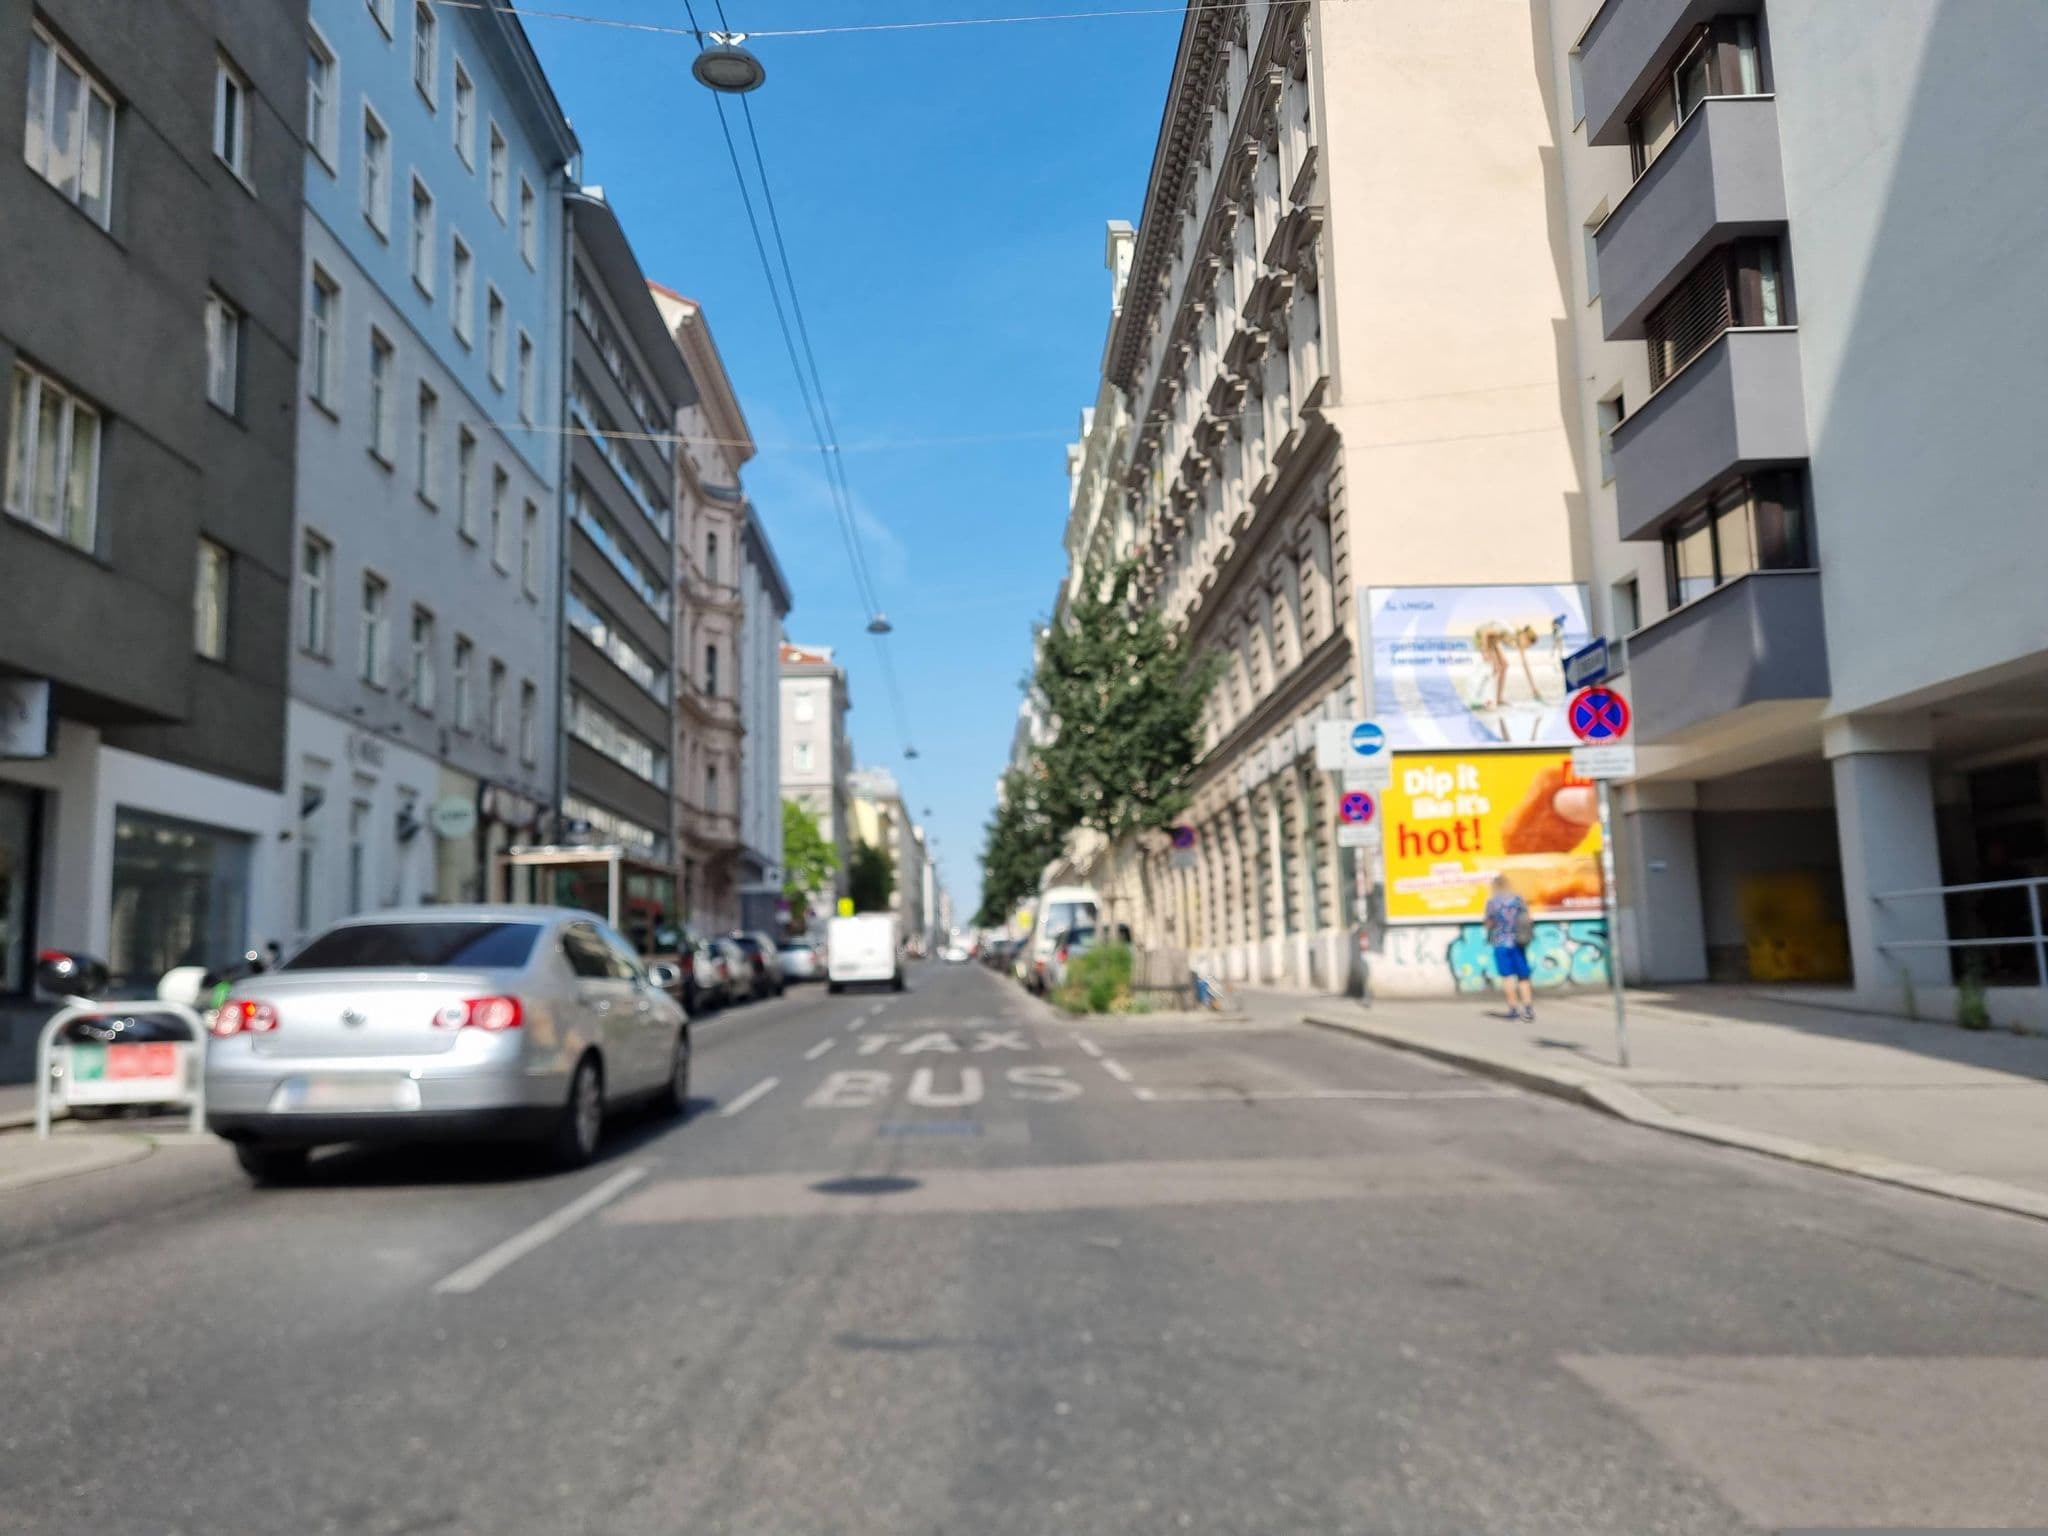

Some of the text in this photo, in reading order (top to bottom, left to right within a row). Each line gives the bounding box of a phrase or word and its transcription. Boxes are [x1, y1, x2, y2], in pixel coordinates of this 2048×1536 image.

[1403, 763, 1480, 799] Dip it
[1412, 796, 1454, 819] like
[1398, 818, 1482, 857] hot!
[804, 1064, 1083, 1108] BUS
